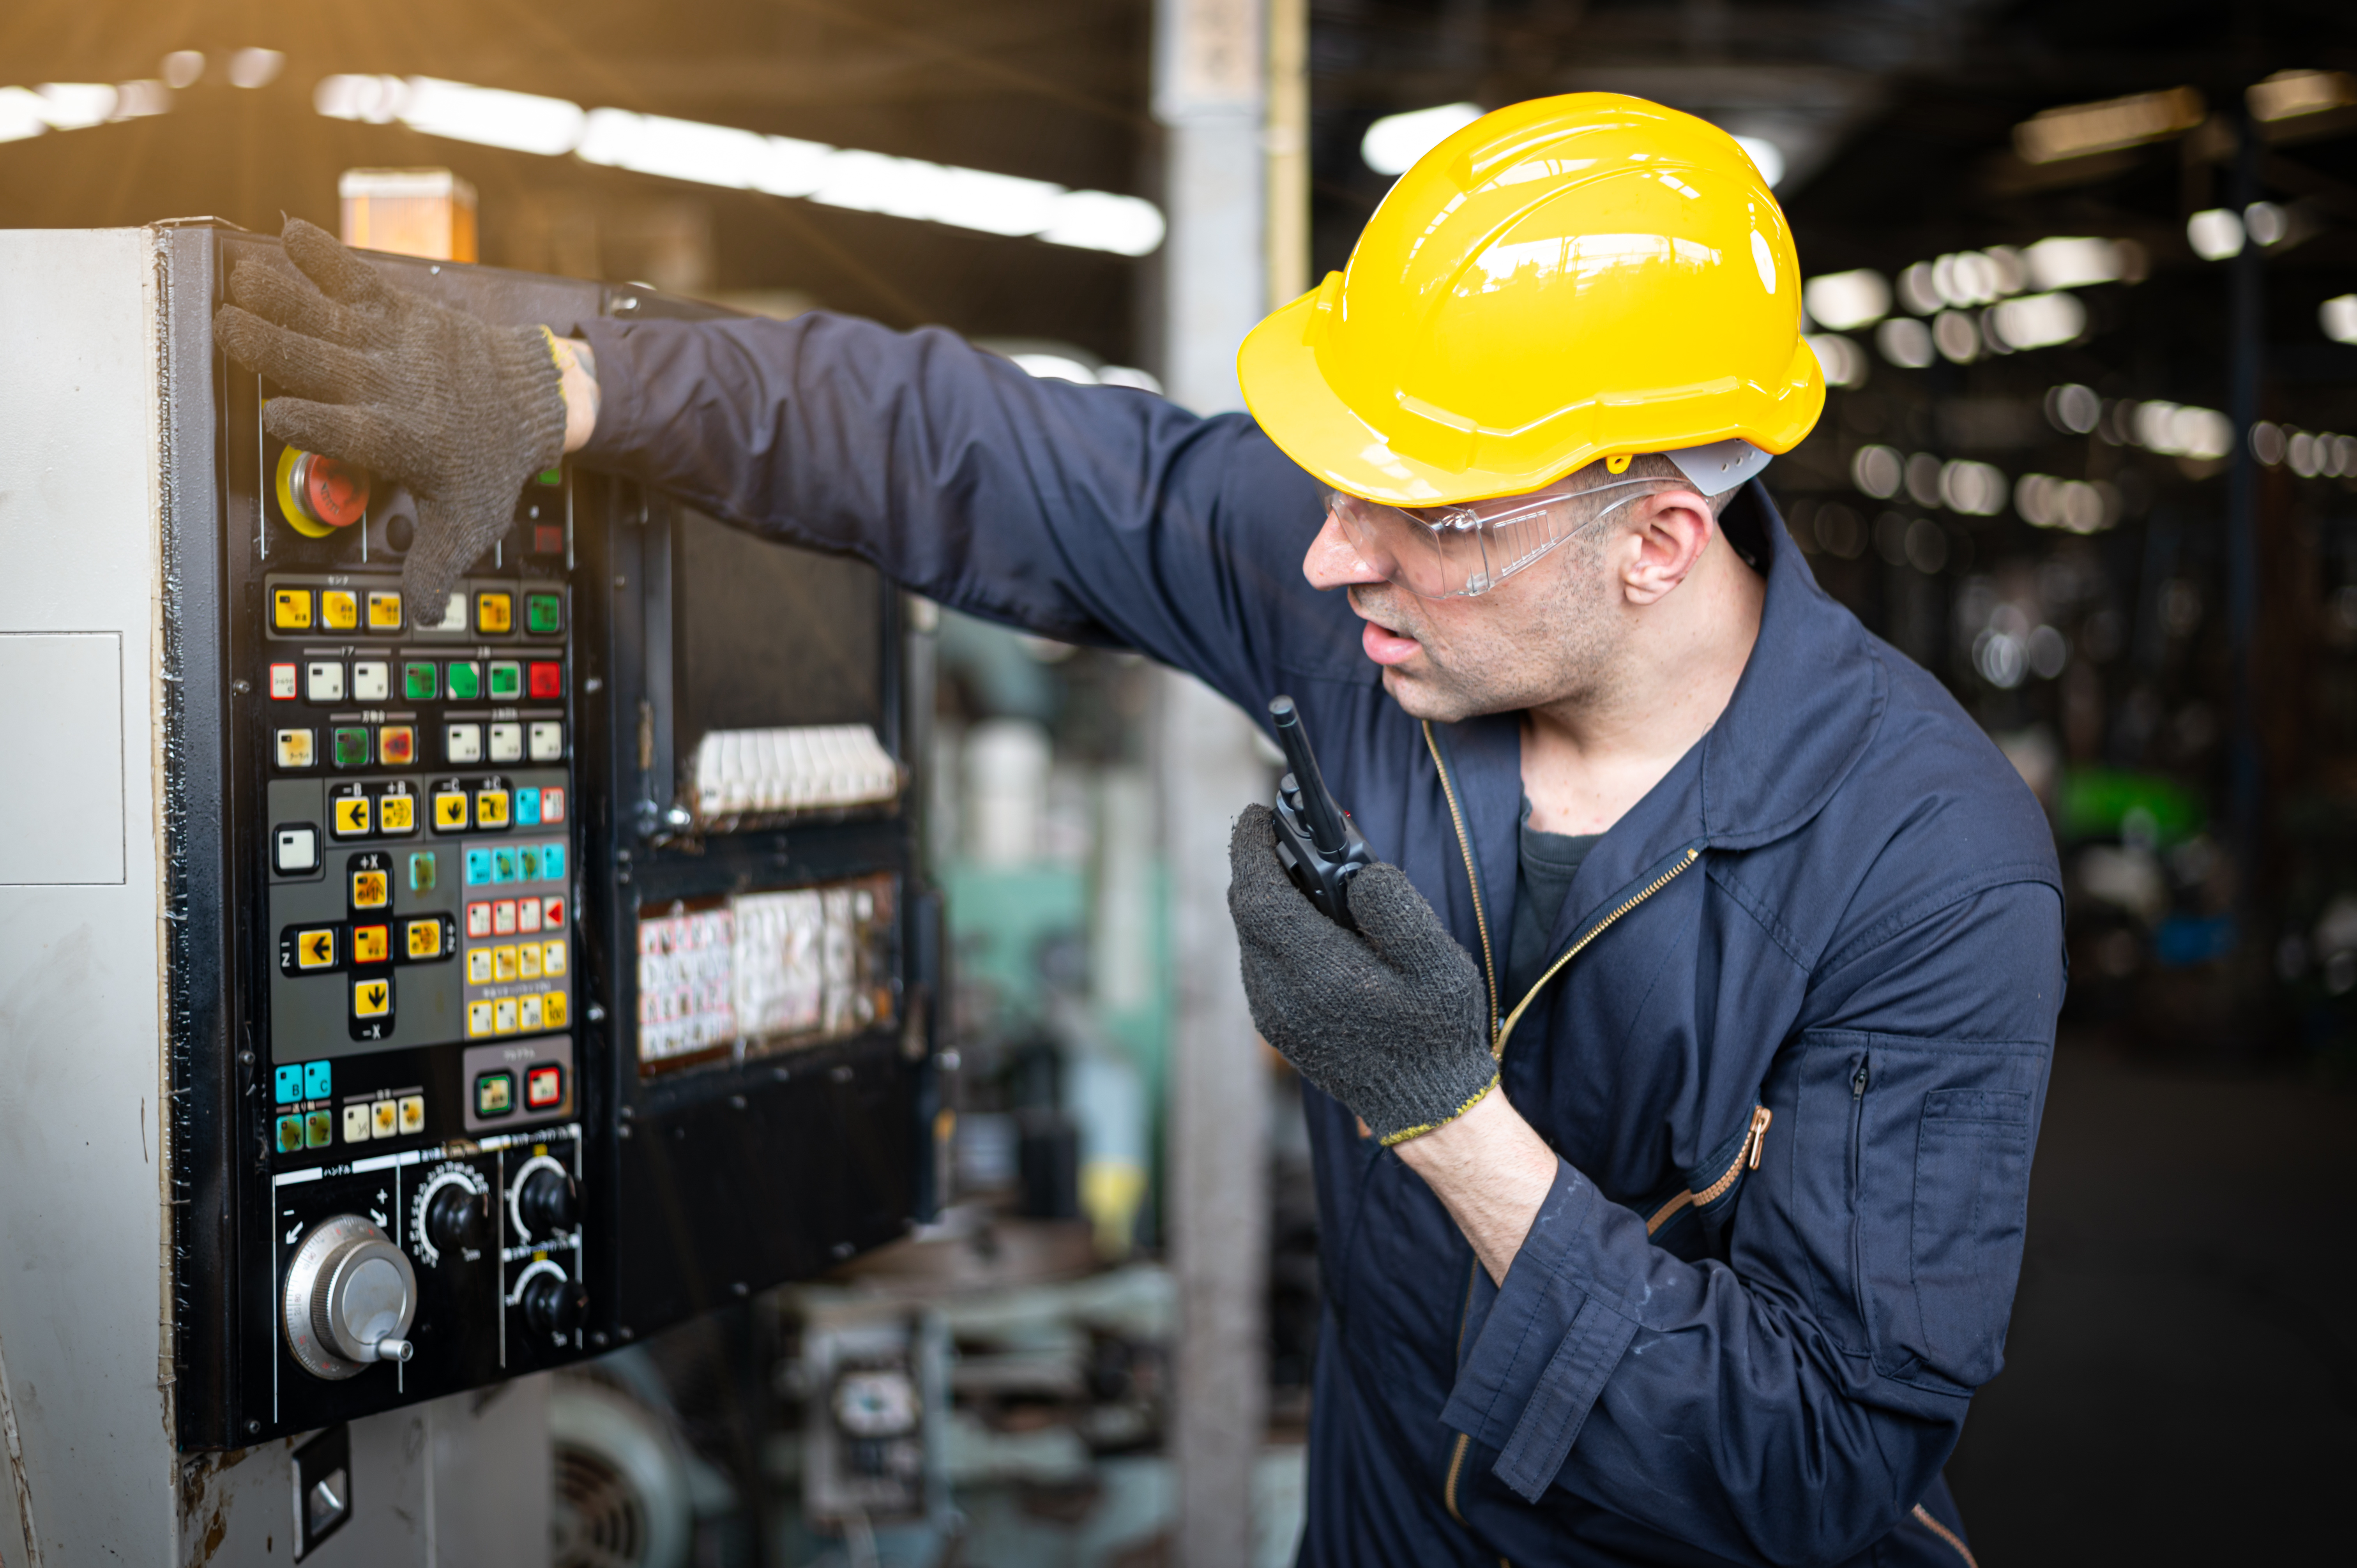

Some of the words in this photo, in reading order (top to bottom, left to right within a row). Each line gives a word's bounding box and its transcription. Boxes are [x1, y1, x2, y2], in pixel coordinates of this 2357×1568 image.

[293, 1084, 299, 1096] B
[320, 1080, 328, 1093] C
[293, 1134, 300, 1145] X
[322, 1128, 329, 1141] Z
[324, 1164, 351, 1176] ハンドル
